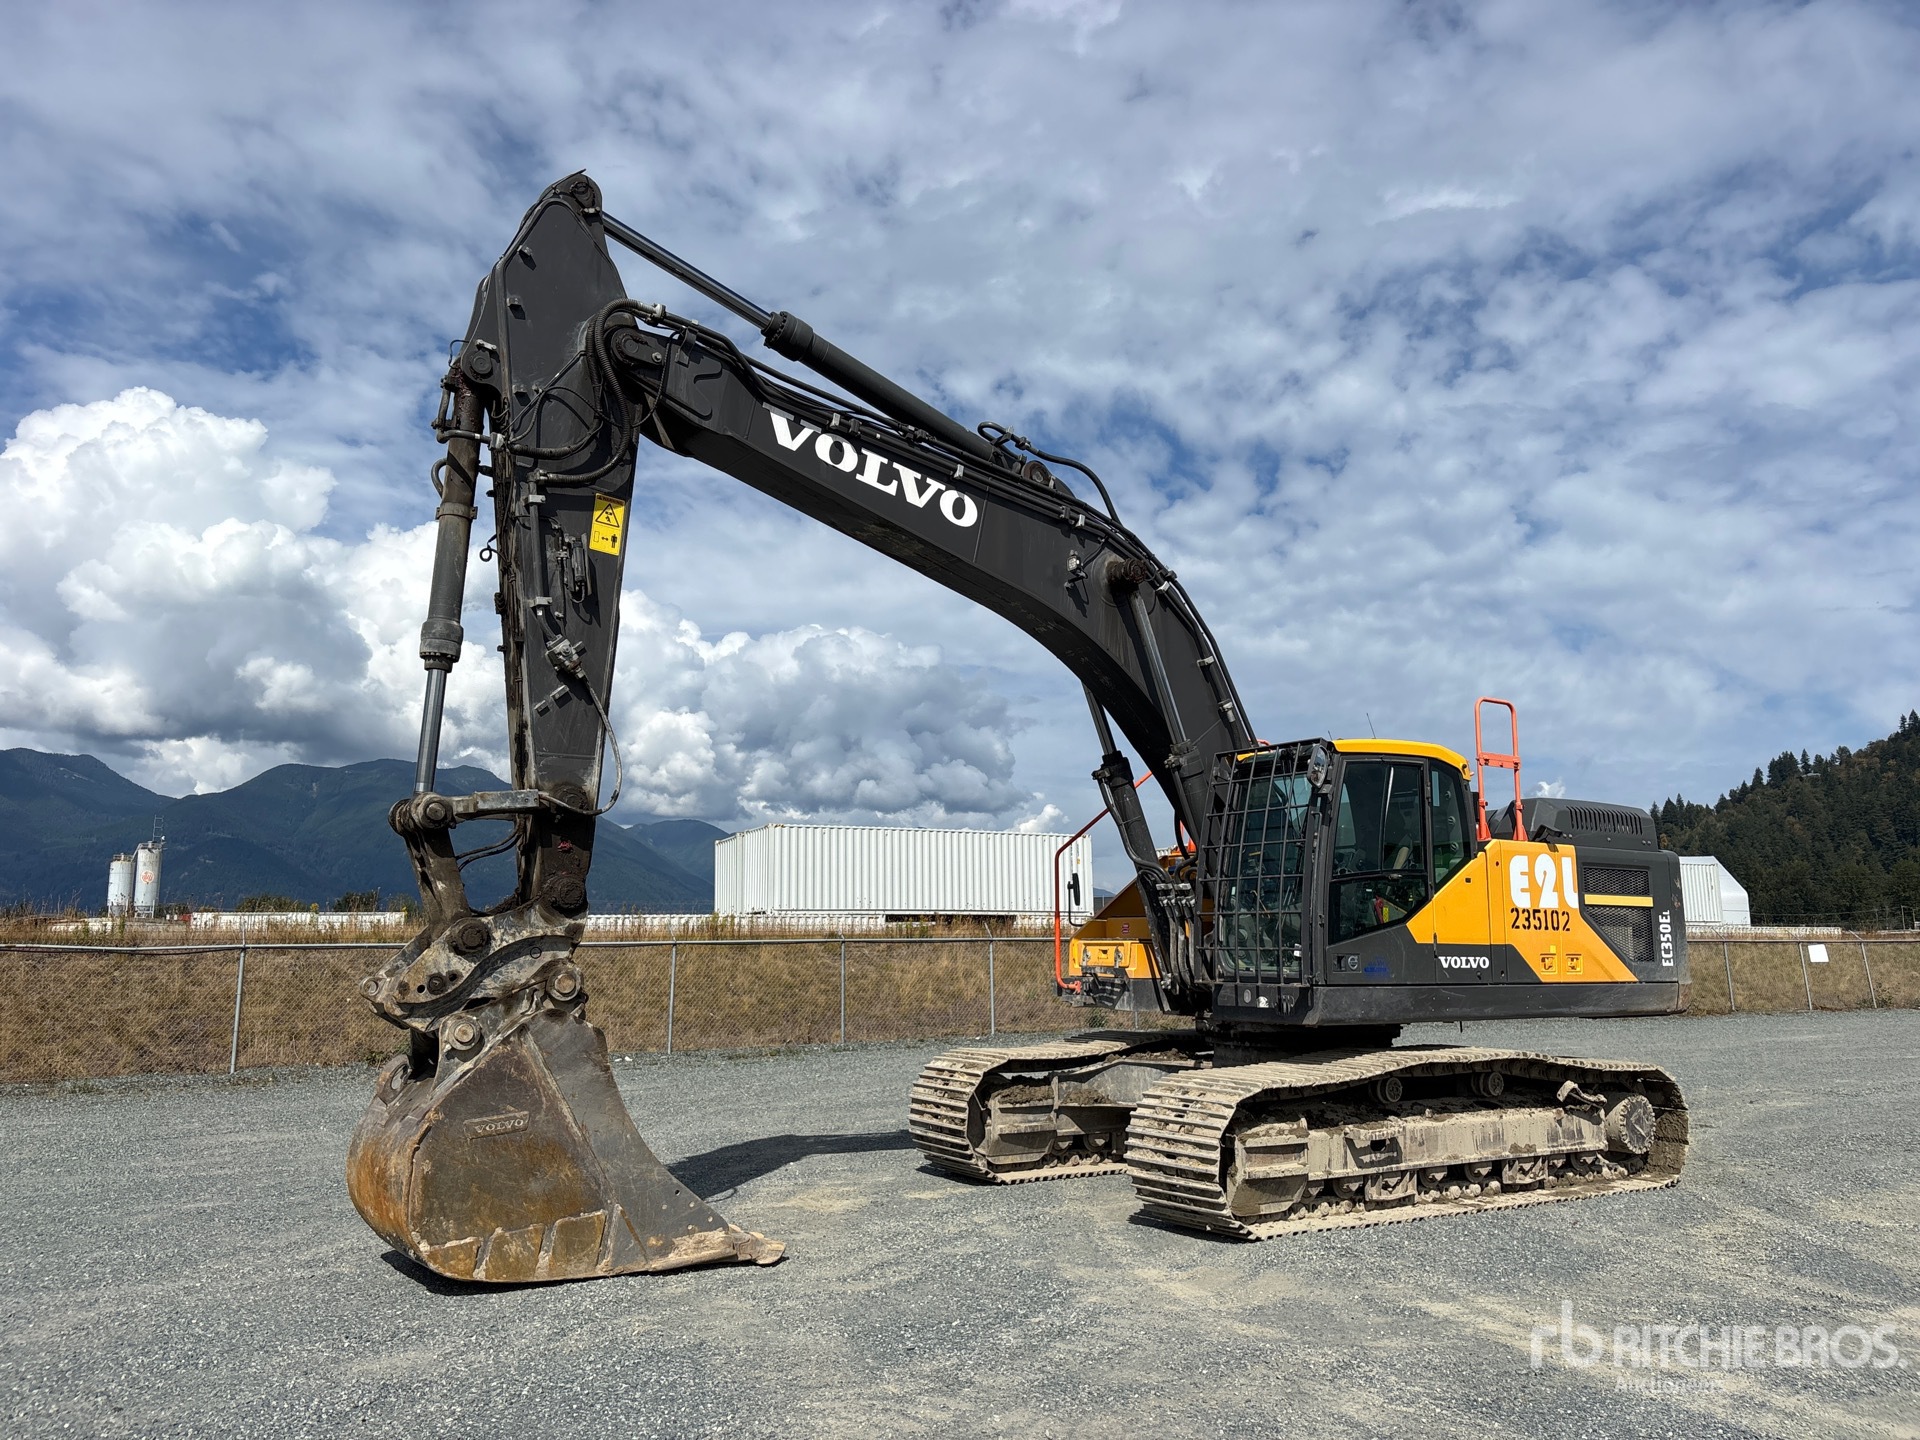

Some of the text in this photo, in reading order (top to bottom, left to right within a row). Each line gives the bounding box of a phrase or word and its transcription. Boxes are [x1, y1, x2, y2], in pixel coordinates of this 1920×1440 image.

[762, 402, 978, 528] VOLVO
[1510, 907, 1571, 932] 235102
[1438, 956, 1490, 969] VOLVO
[474, 1118, 524, 1133] VOLVO
